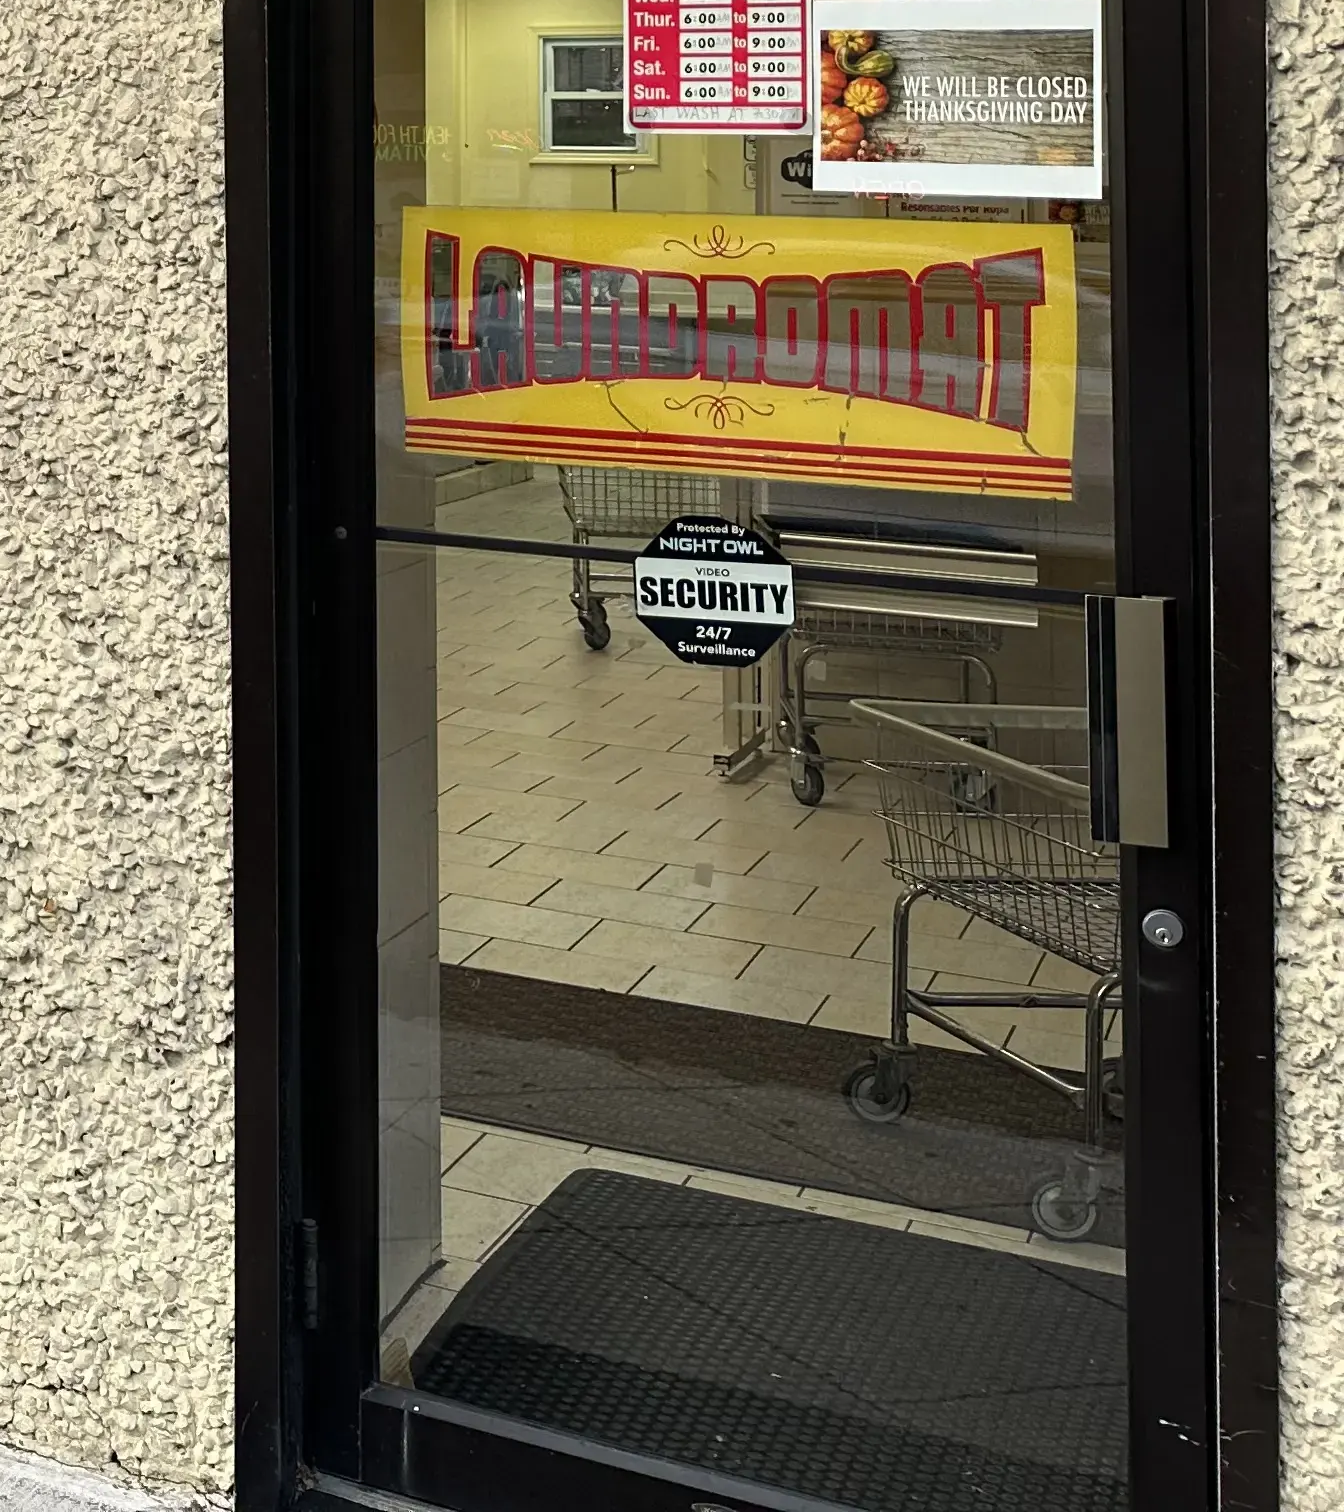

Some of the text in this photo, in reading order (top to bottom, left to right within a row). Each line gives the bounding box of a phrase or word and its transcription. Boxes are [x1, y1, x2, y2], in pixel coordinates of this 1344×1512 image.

[633, 11, 675, 28] Thur.
[684, 13, 716, 24] 6:00
[734, 12, 746, 24] to
[752, 12, 785, 24] 9:00
[633, 36, 660, 52] Fri.
[684, 37, 715, 49] 6:00
[734, 36, 746, 48] to
[752, 37, 786, 49] 9:00
[633, 60, 666, 76] Sat.
[684, 62, 717, 73] 6:00
[734, 62, 747, 73] to
[752, 62, 785, 73] 9:00
[633, 84, 671, 100] Sun.
[684, 87, 717, 98] 6:00
[734, 86, 747, 97] to
[752, 86, 785, 97] 9:00
[903, 75, 1088, 99] WE WILL BE CLOSED
[635, 107, 666, 118] LAST
[676, 106, 720, 119] WASH
[727, 108, 744, 121] AT
[903, 100, 1087, 124] THANKSGIVING DAY
[426, 230, 1045, 433] LAUNDROMAT
[676, 522, 745, 536] Protected By
[660, 537, 764, 555] NIGHT OWL
[695, 566, 730, 577] VIDEO
[640, 576, 788, 615] SECURITY
[695, 625, 732, 640] 24/7
[677, 641, 756, 657] Surveillance
